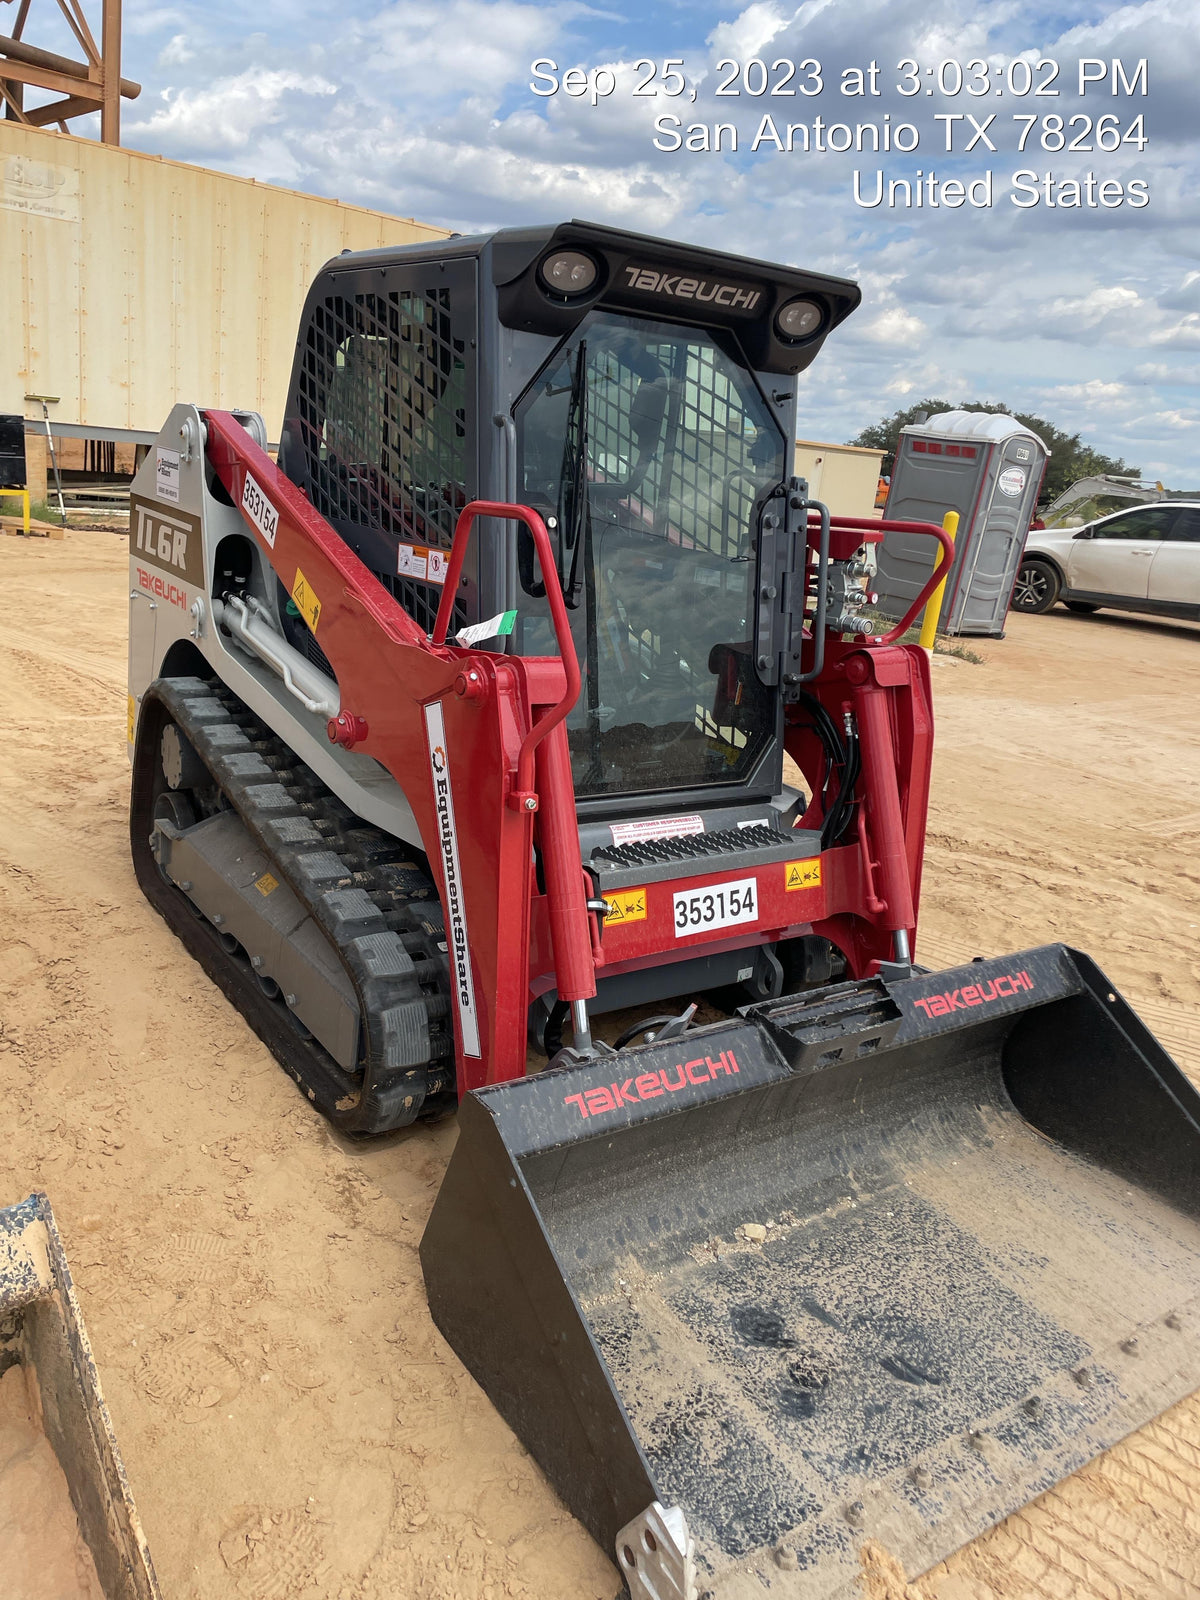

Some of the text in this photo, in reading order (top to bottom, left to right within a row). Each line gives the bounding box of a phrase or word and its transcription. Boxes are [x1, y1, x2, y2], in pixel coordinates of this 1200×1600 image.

[135, 503, 193, 571] TL6R
[243, 479, 276, 539] 353154
[436, 778, 469, 1007] EquipmentShare
[675, 886, 755, 928] 353154
